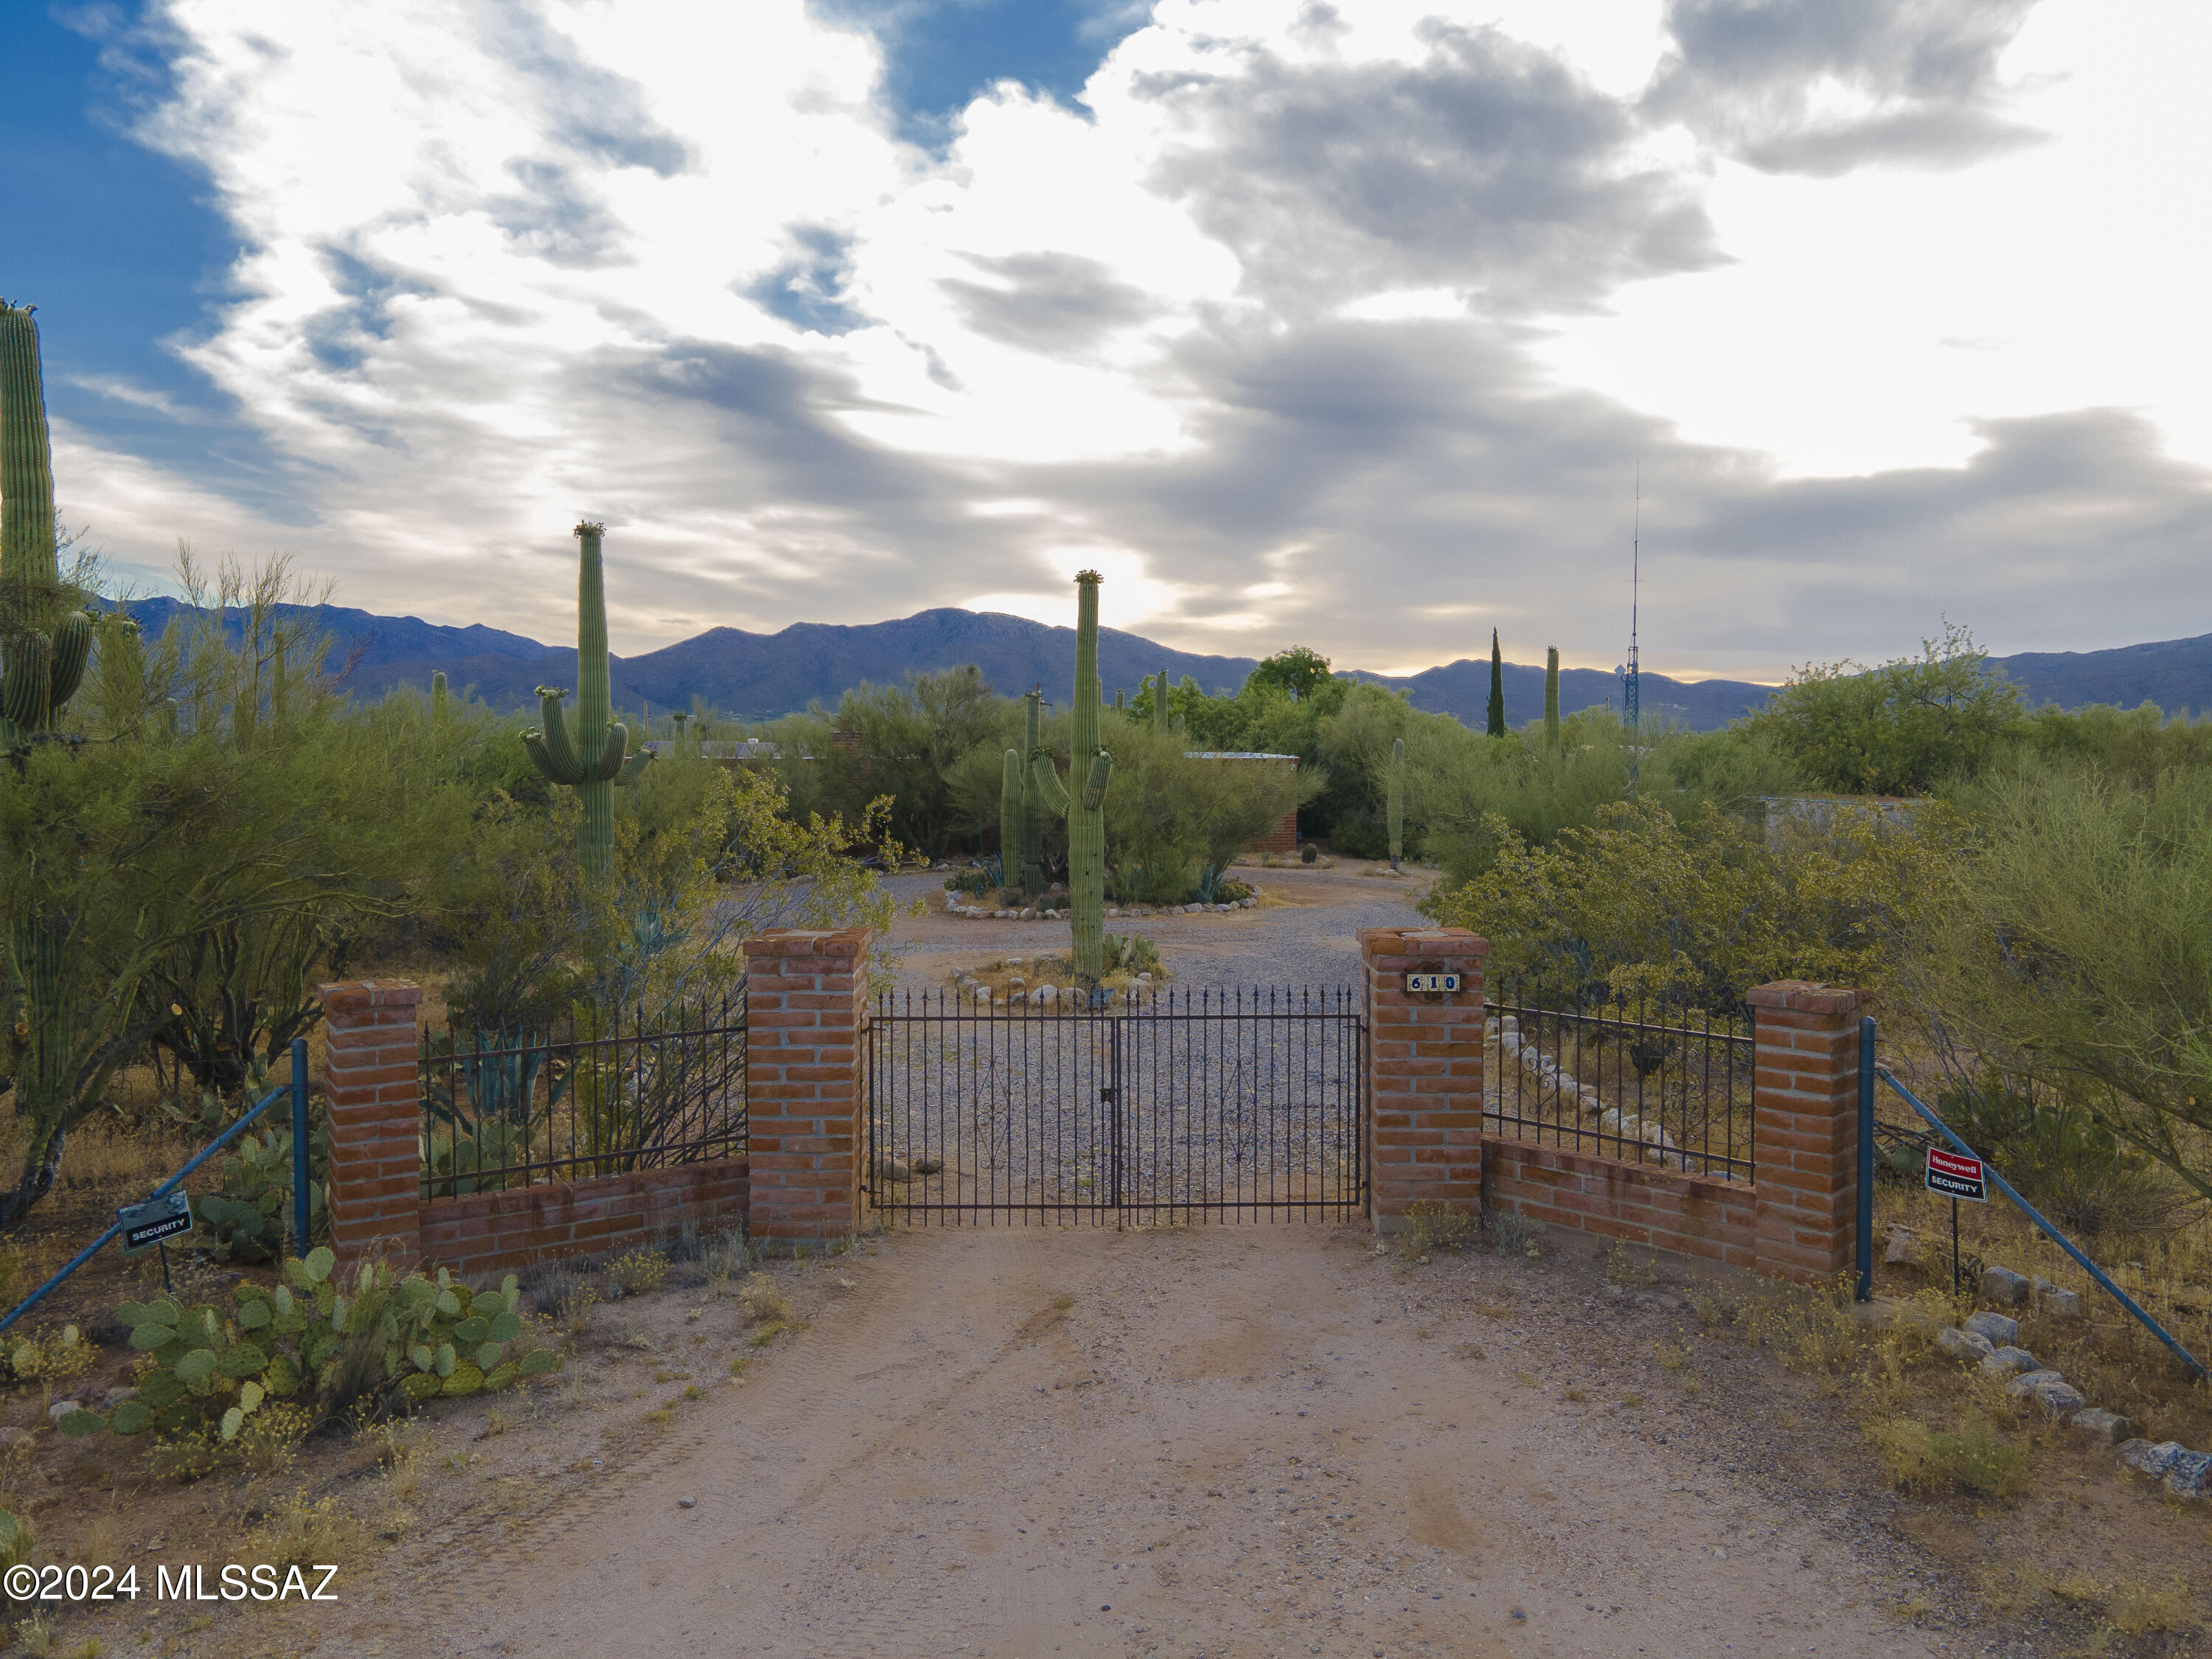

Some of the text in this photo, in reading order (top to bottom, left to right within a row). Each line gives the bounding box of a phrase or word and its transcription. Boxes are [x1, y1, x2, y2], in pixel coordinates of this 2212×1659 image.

[1411, 976, 1455, 990] 610
[1933, 1155, 1977, 1174] Honeywell
[1932, 1175, 1978, 1193] SECURITY
[132, 1218, 184, 1241] SECURITY
